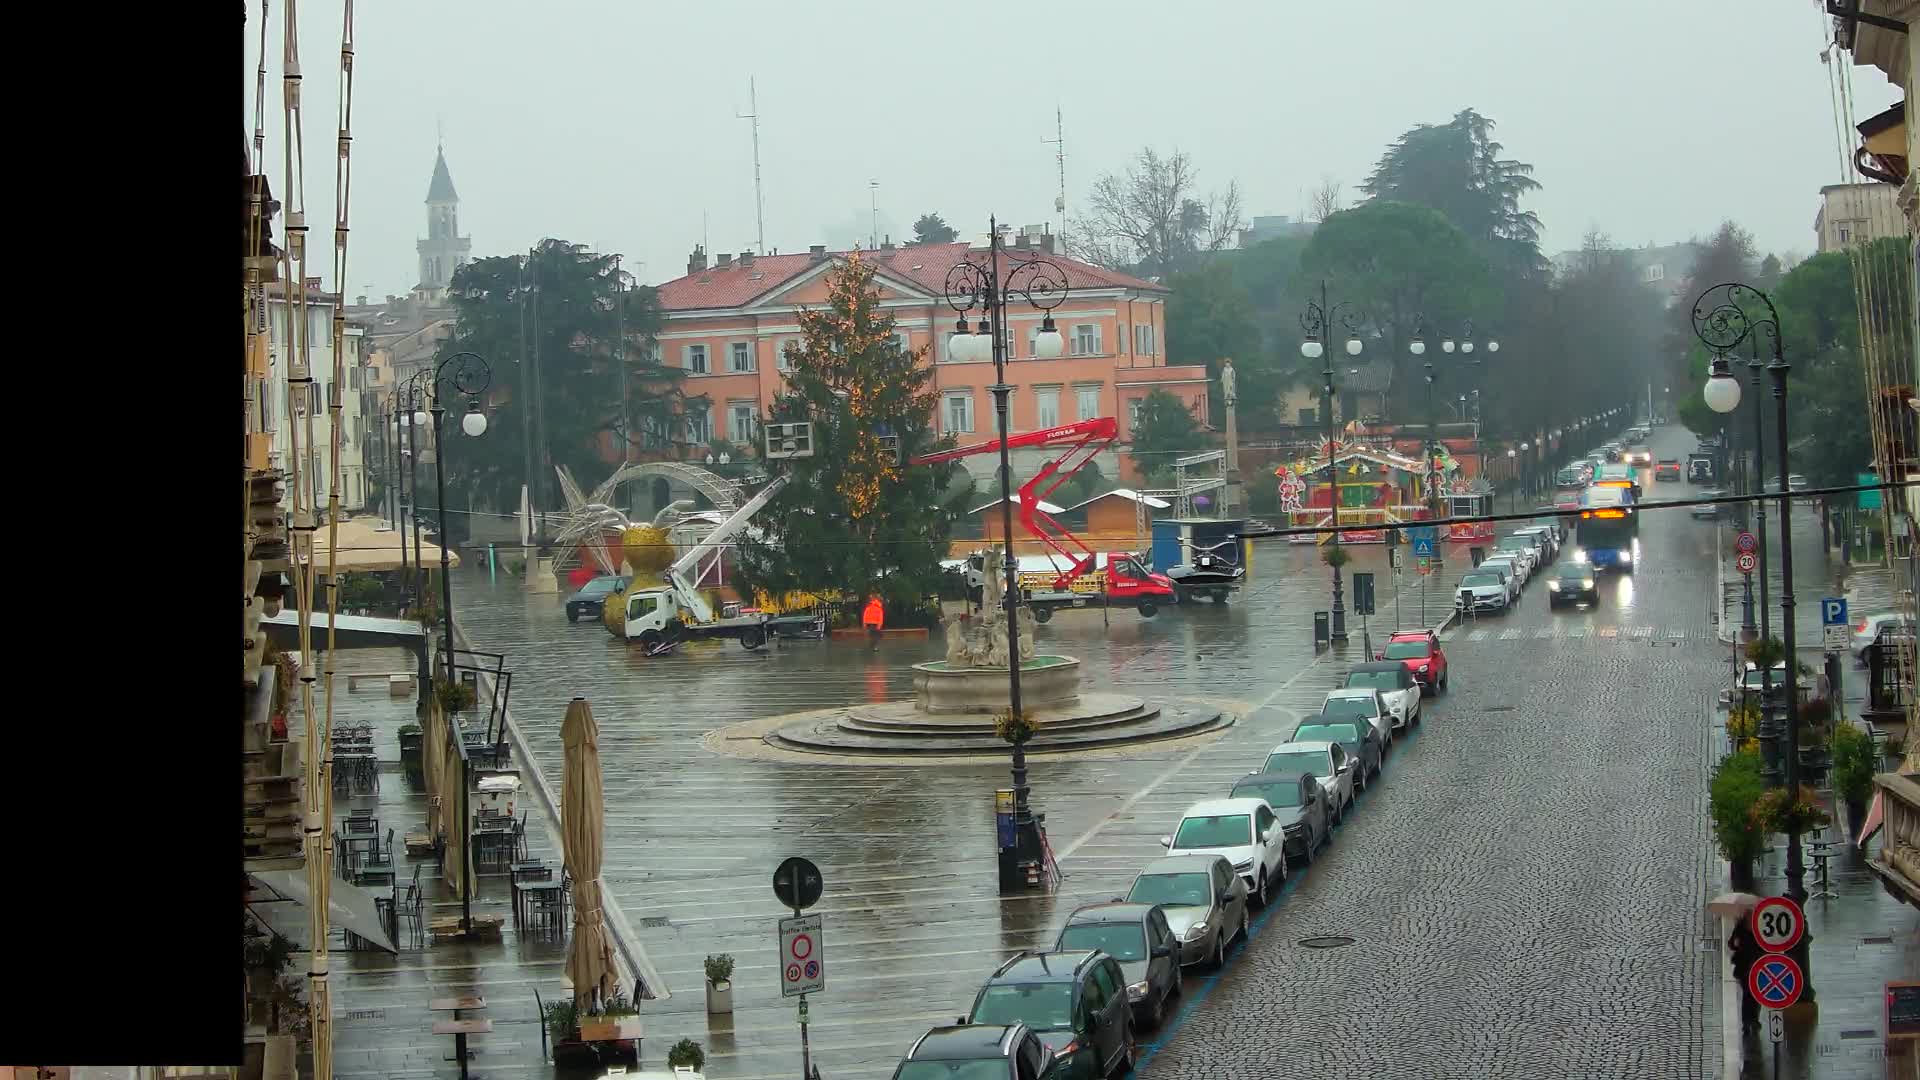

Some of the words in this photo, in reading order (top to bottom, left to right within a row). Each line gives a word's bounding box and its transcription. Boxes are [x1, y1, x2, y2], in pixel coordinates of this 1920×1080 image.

[1742, 557, 1752, 567] 20
[1827, 602, 1842, 622] P
[1762, 911, 1791, 937] 30
